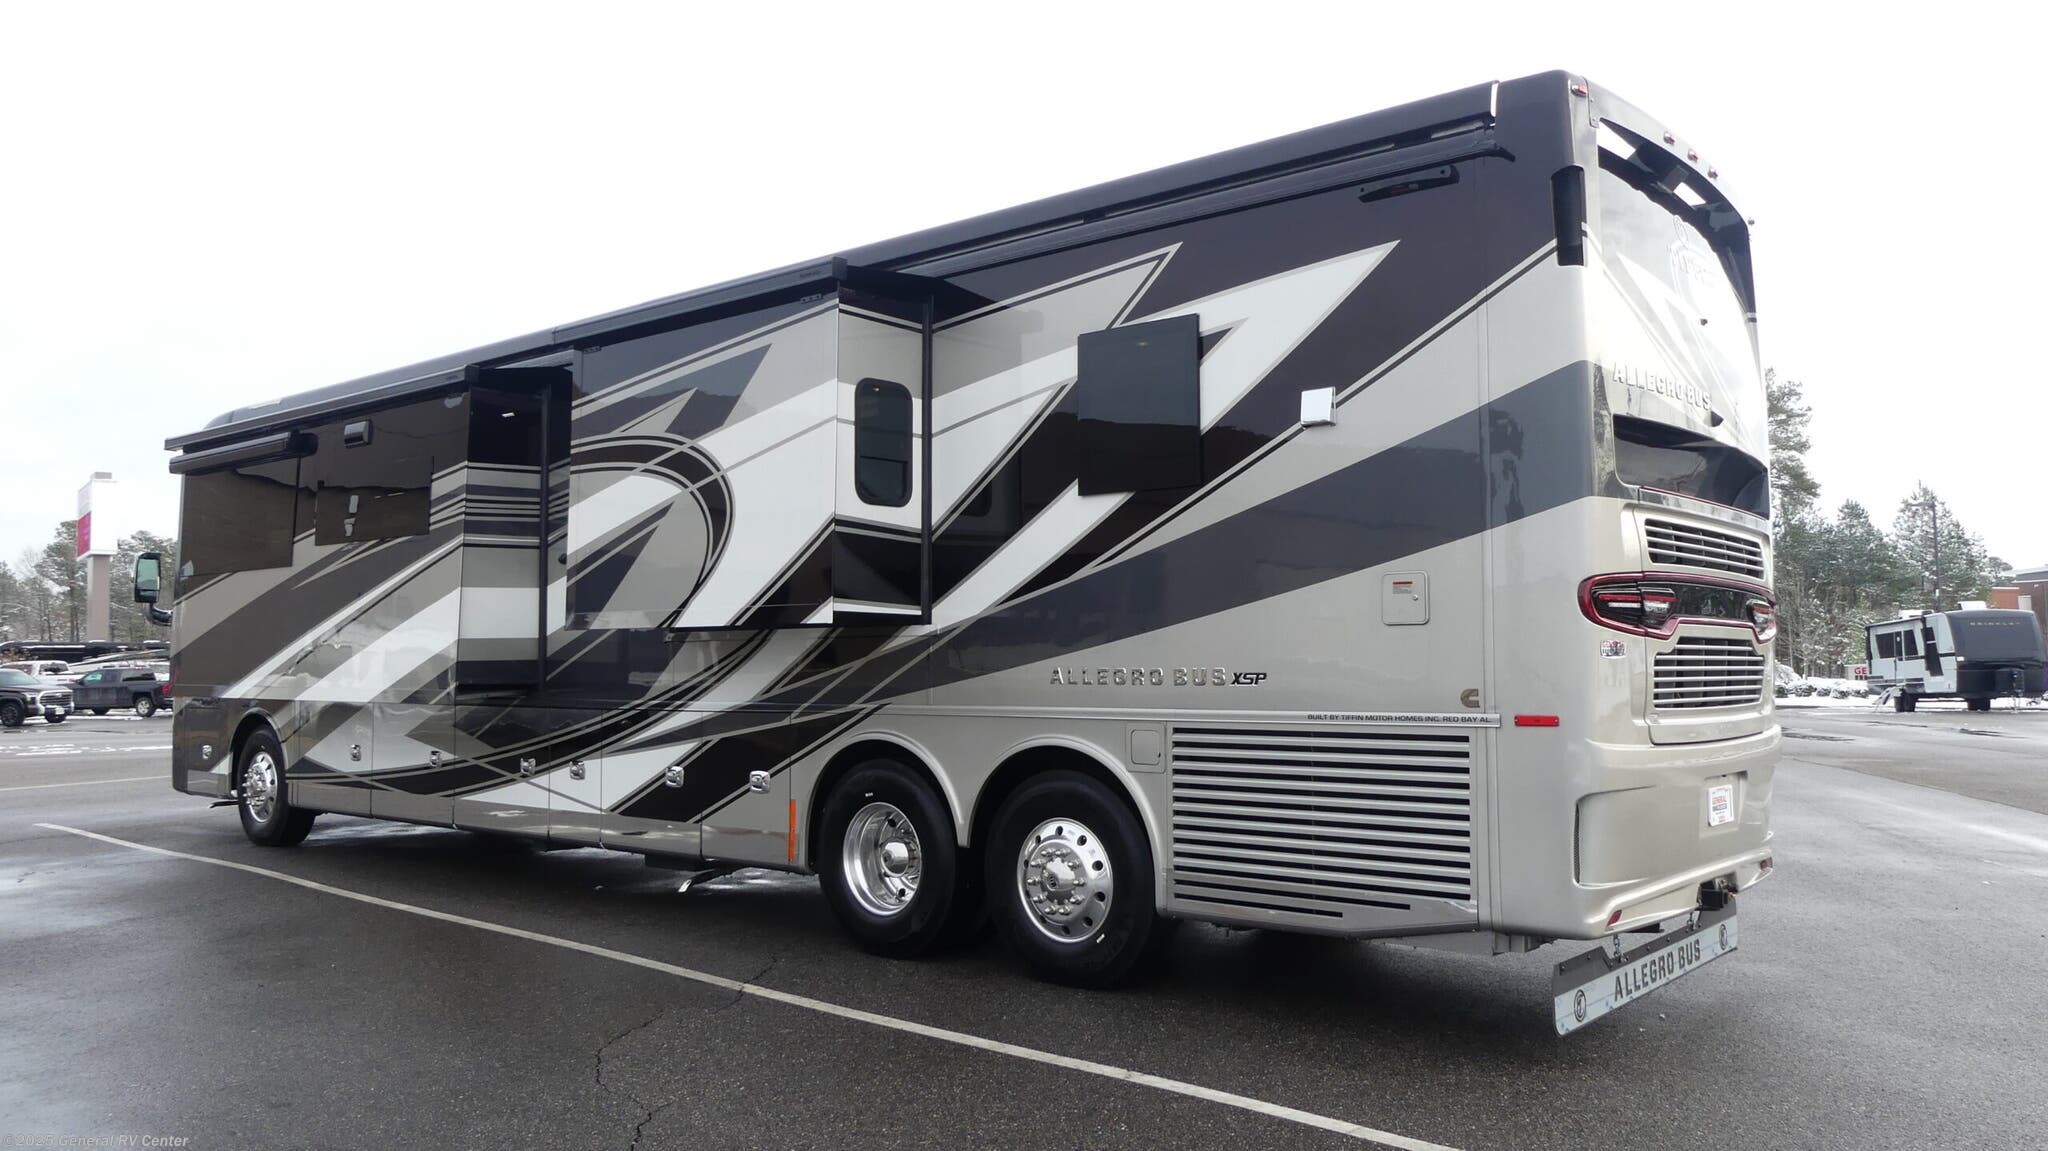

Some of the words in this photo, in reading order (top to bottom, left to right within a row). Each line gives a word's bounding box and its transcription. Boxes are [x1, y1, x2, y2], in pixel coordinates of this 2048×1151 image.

[1612, 361, 1683, 401] ALLEGRO
[1684, 383, 1712, 411] BUS
[1050, 667, 1164, 686] ALLEGRO
[1173, 667, 1227, 686] BUS
[1230, 672, 1267, 686] XSP
[1614, 951, 1674, 1001] ALLEGRO
[1678, 938, 1701, 969] BUS
